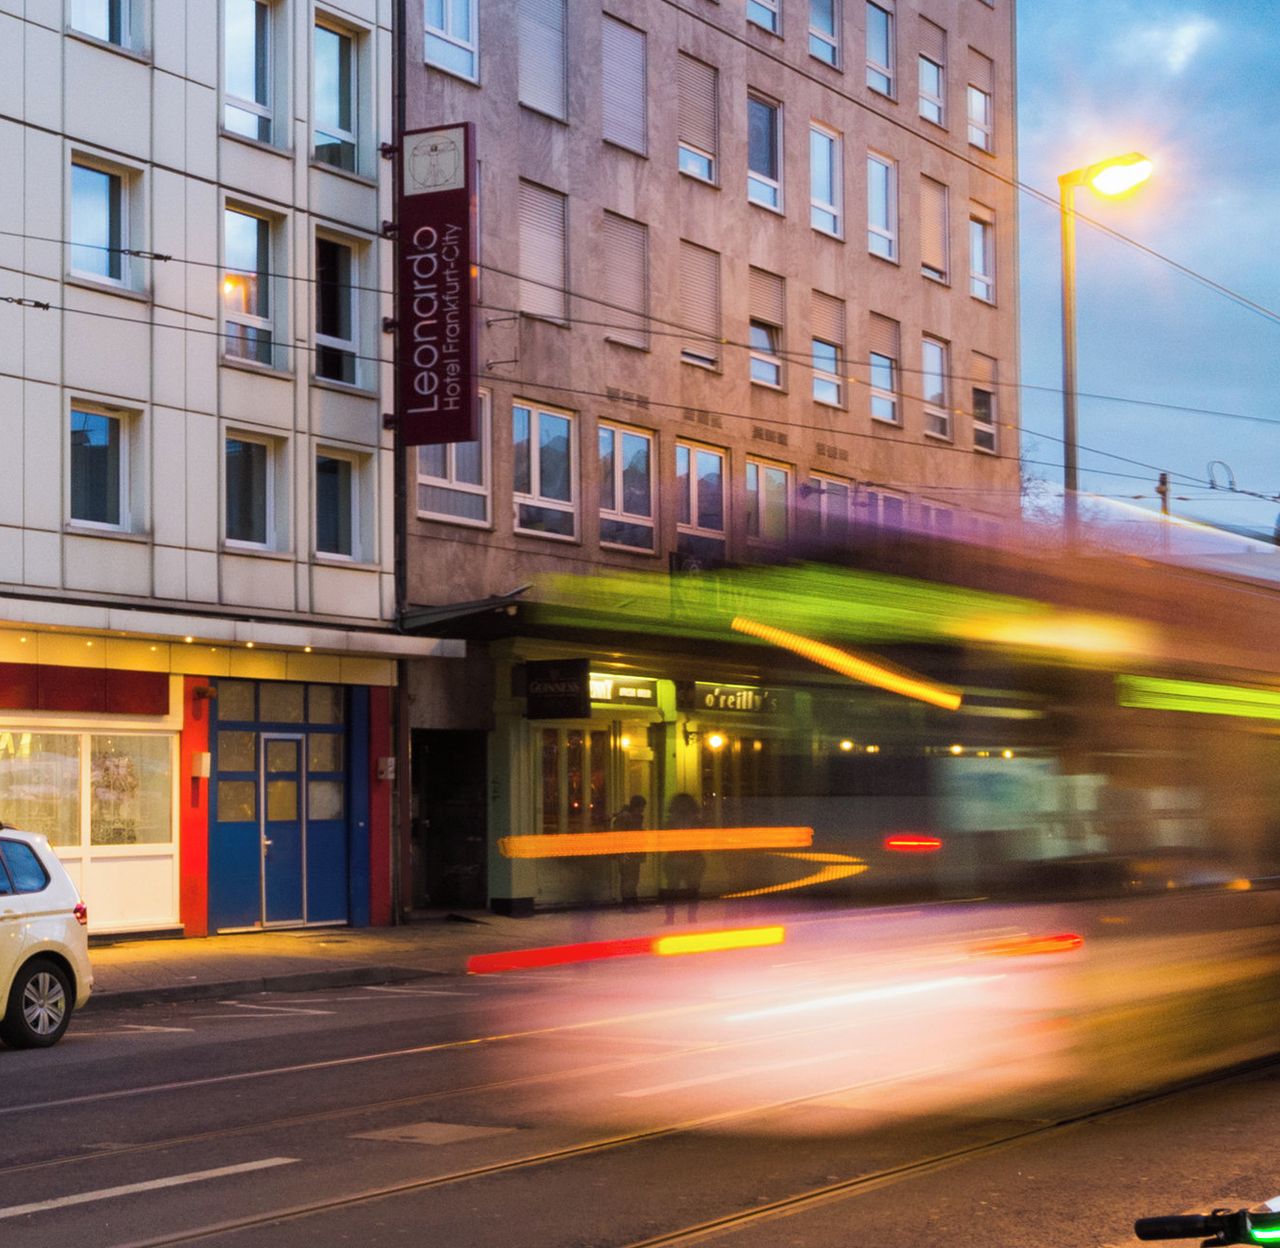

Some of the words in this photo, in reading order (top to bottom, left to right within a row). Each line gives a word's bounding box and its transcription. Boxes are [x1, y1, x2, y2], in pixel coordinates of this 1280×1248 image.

[406, 226, 439, 413] Leonardo
[442, 223, 463, 354] Frankfurt-City
[443, 361, 460, 411] Hotel
